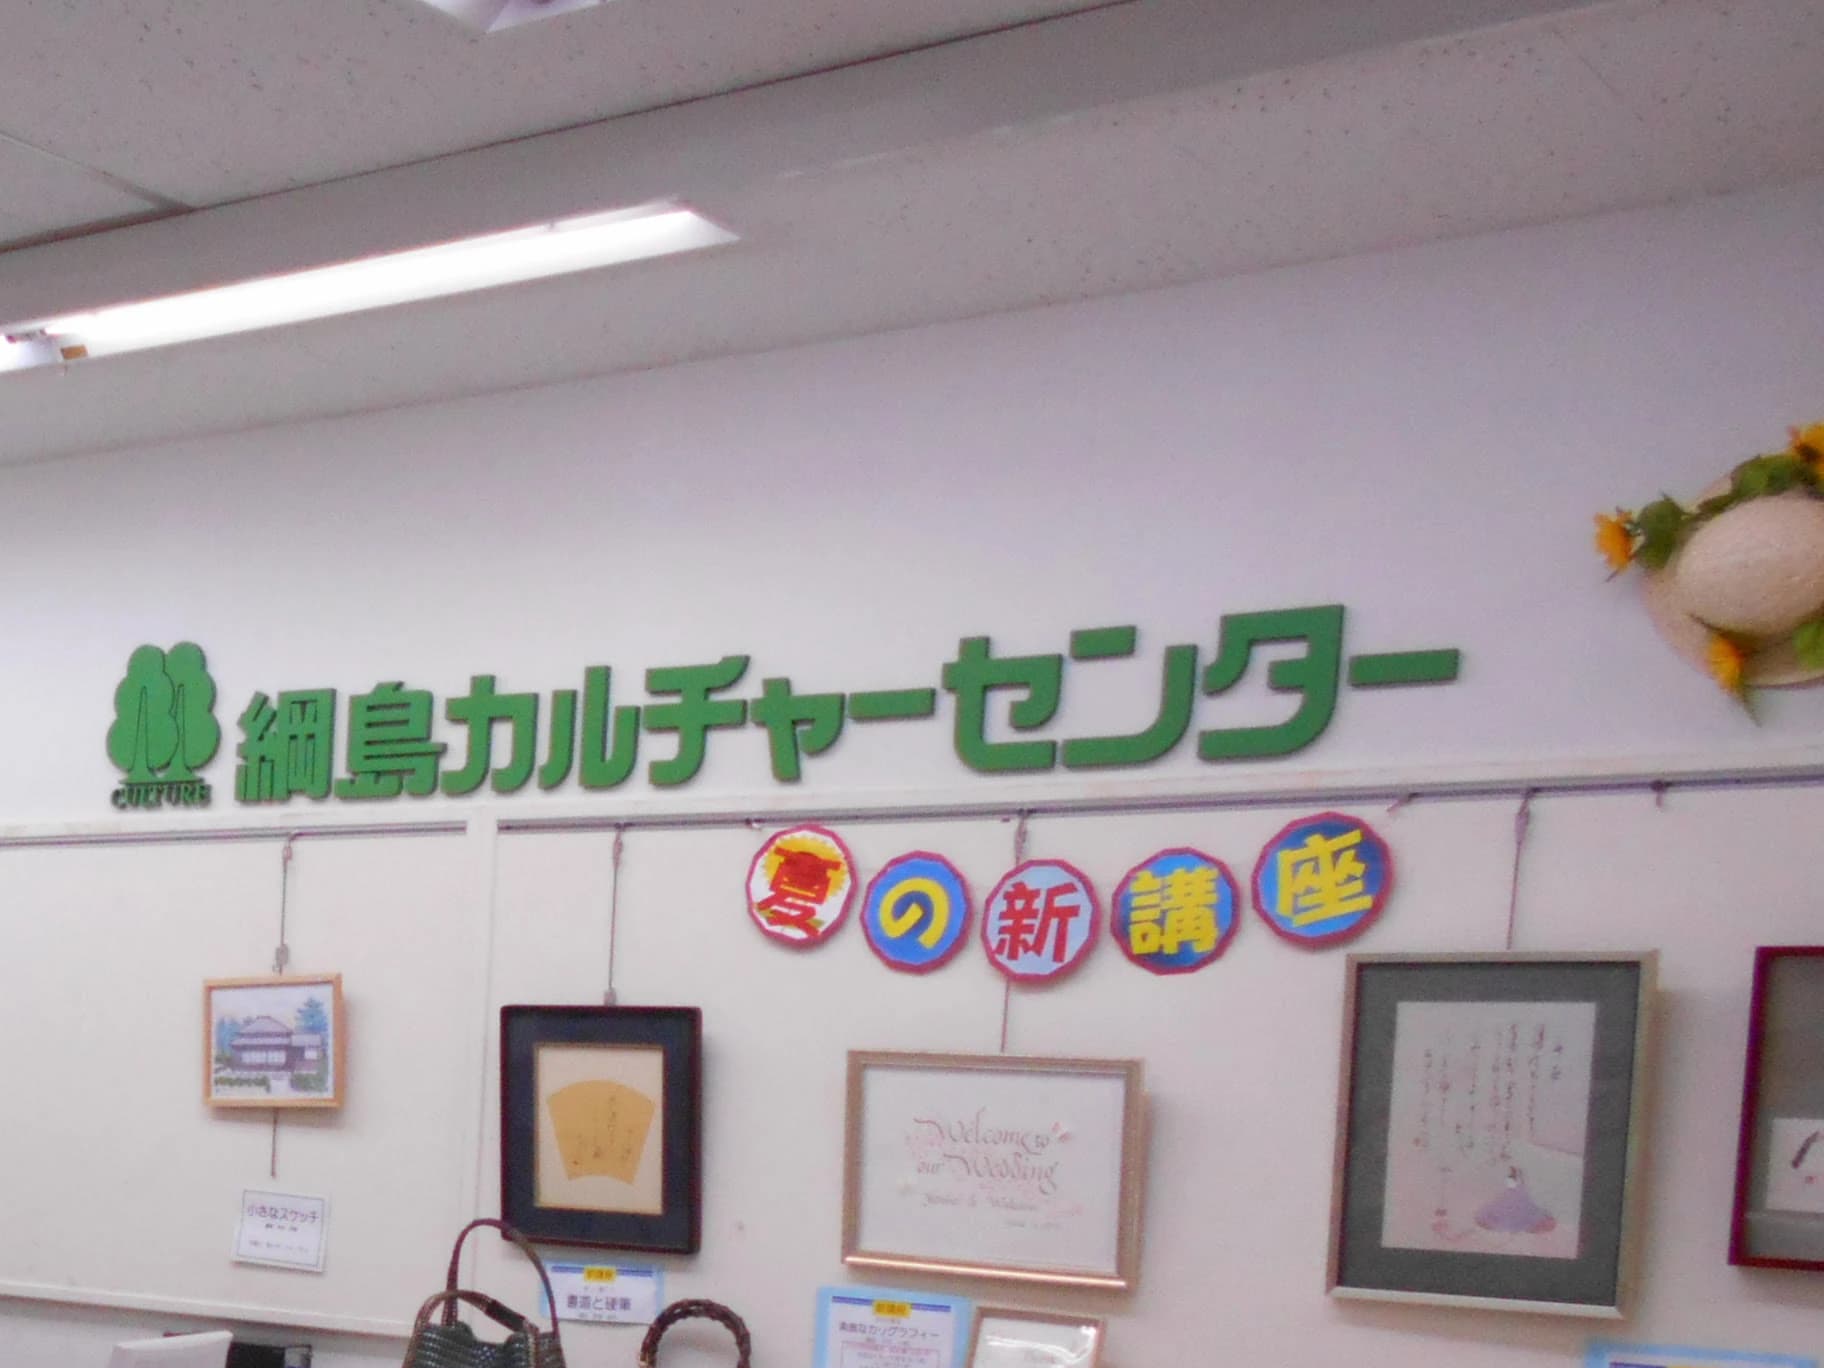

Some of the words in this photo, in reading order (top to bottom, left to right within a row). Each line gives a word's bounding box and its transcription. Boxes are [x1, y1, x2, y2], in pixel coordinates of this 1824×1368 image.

[234, 602, 1461, 805] 綱島カルチャーセンター
[111, 784, 213, 810] CULTURE
[913, 1107, 1043, 1155] Welcome
[943, 1152, 1060, 1195] Wedding
